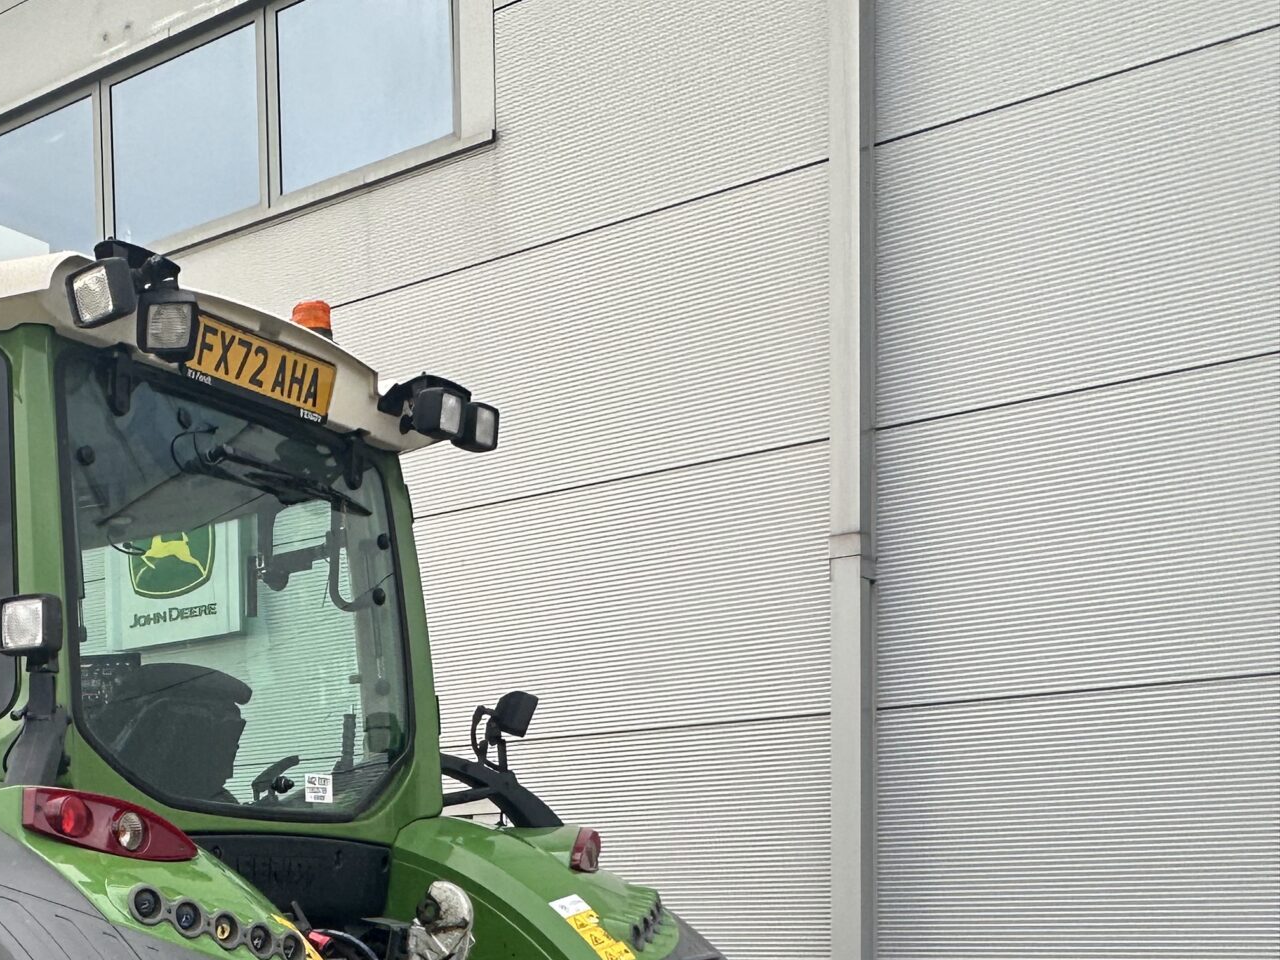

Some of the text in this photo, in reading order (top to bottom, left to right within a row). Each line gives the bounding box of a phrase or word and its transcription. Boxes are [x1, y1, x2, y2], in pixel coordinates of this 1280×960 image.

[196, 323, 320, 408] FX72 AHA
[129, 602, 218, 629] JOHN DEERE
